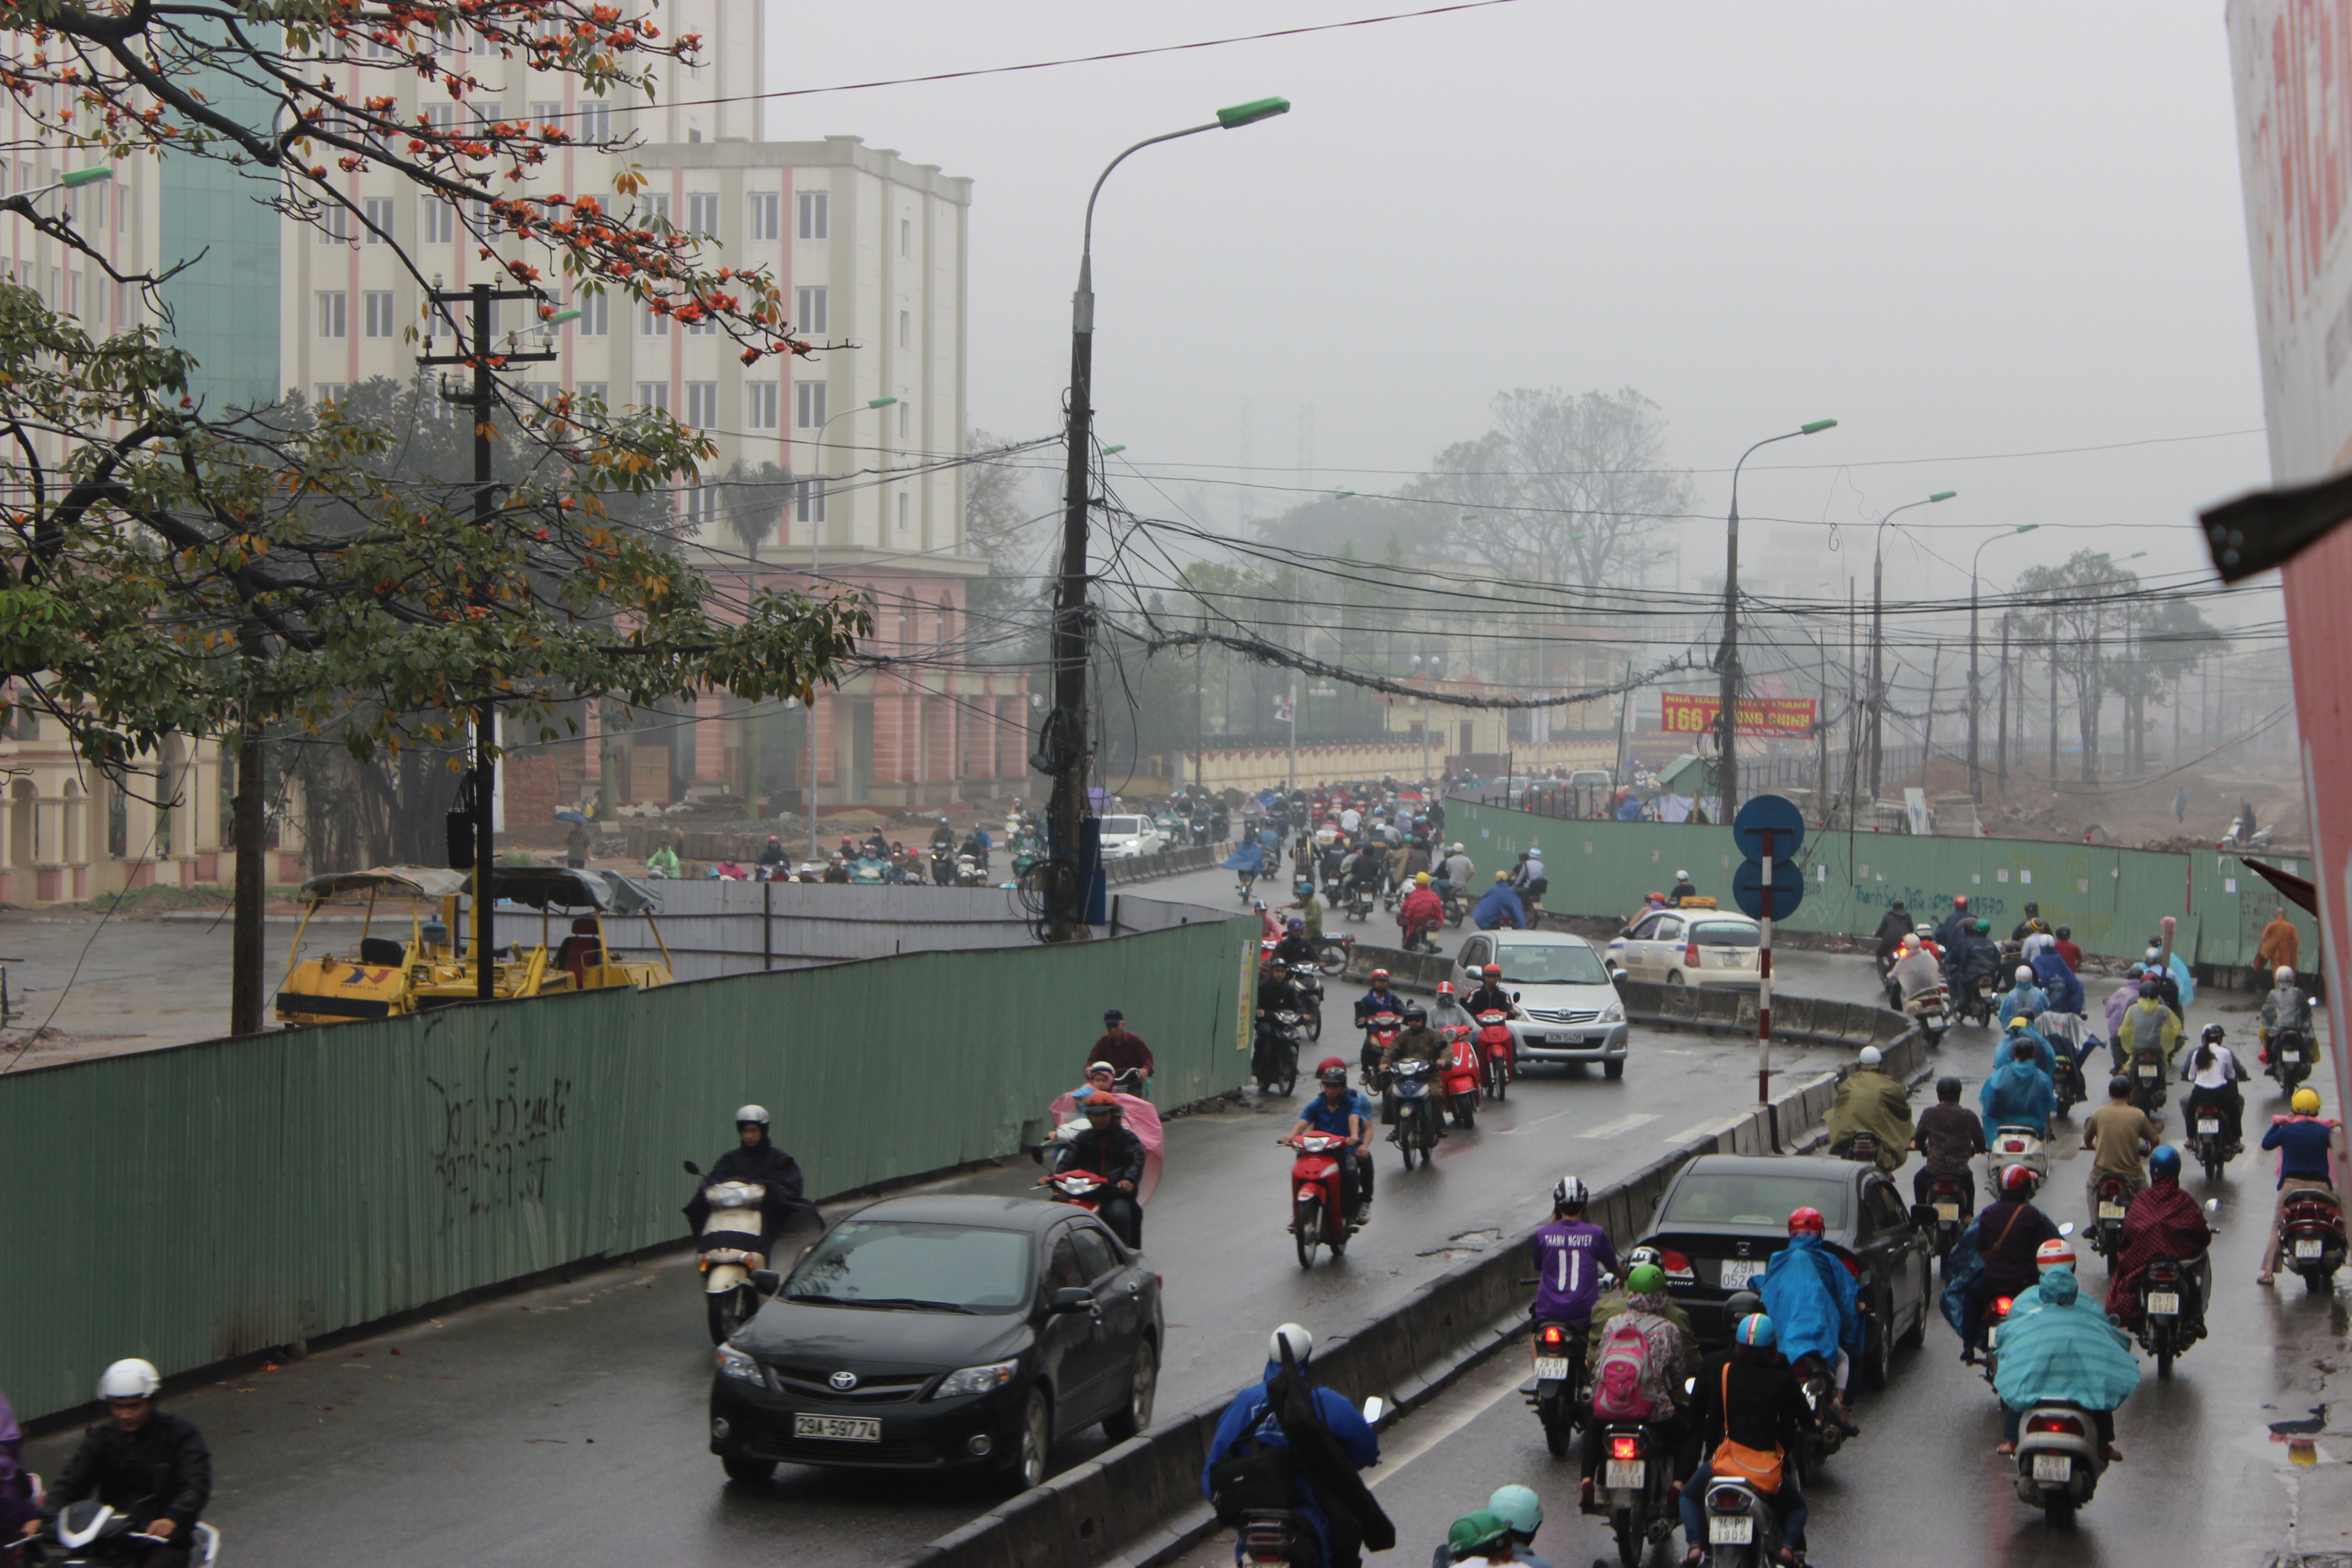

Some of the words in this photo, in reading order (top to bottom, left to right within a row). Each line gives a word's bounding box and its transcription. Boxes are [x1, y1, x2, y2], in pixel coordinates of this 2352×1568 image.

[1665, 706, 1703, 732] 166
[1548, 1033, 1582, 1042] 30N-5408
[1545, 1235, 1565, 1247] THANH
[1567, 1235, 1593, 1247] NGUYEN
[1558, 1249, 1580, 1292] 11
[1733, 1260, 1755, 1275] 29A
